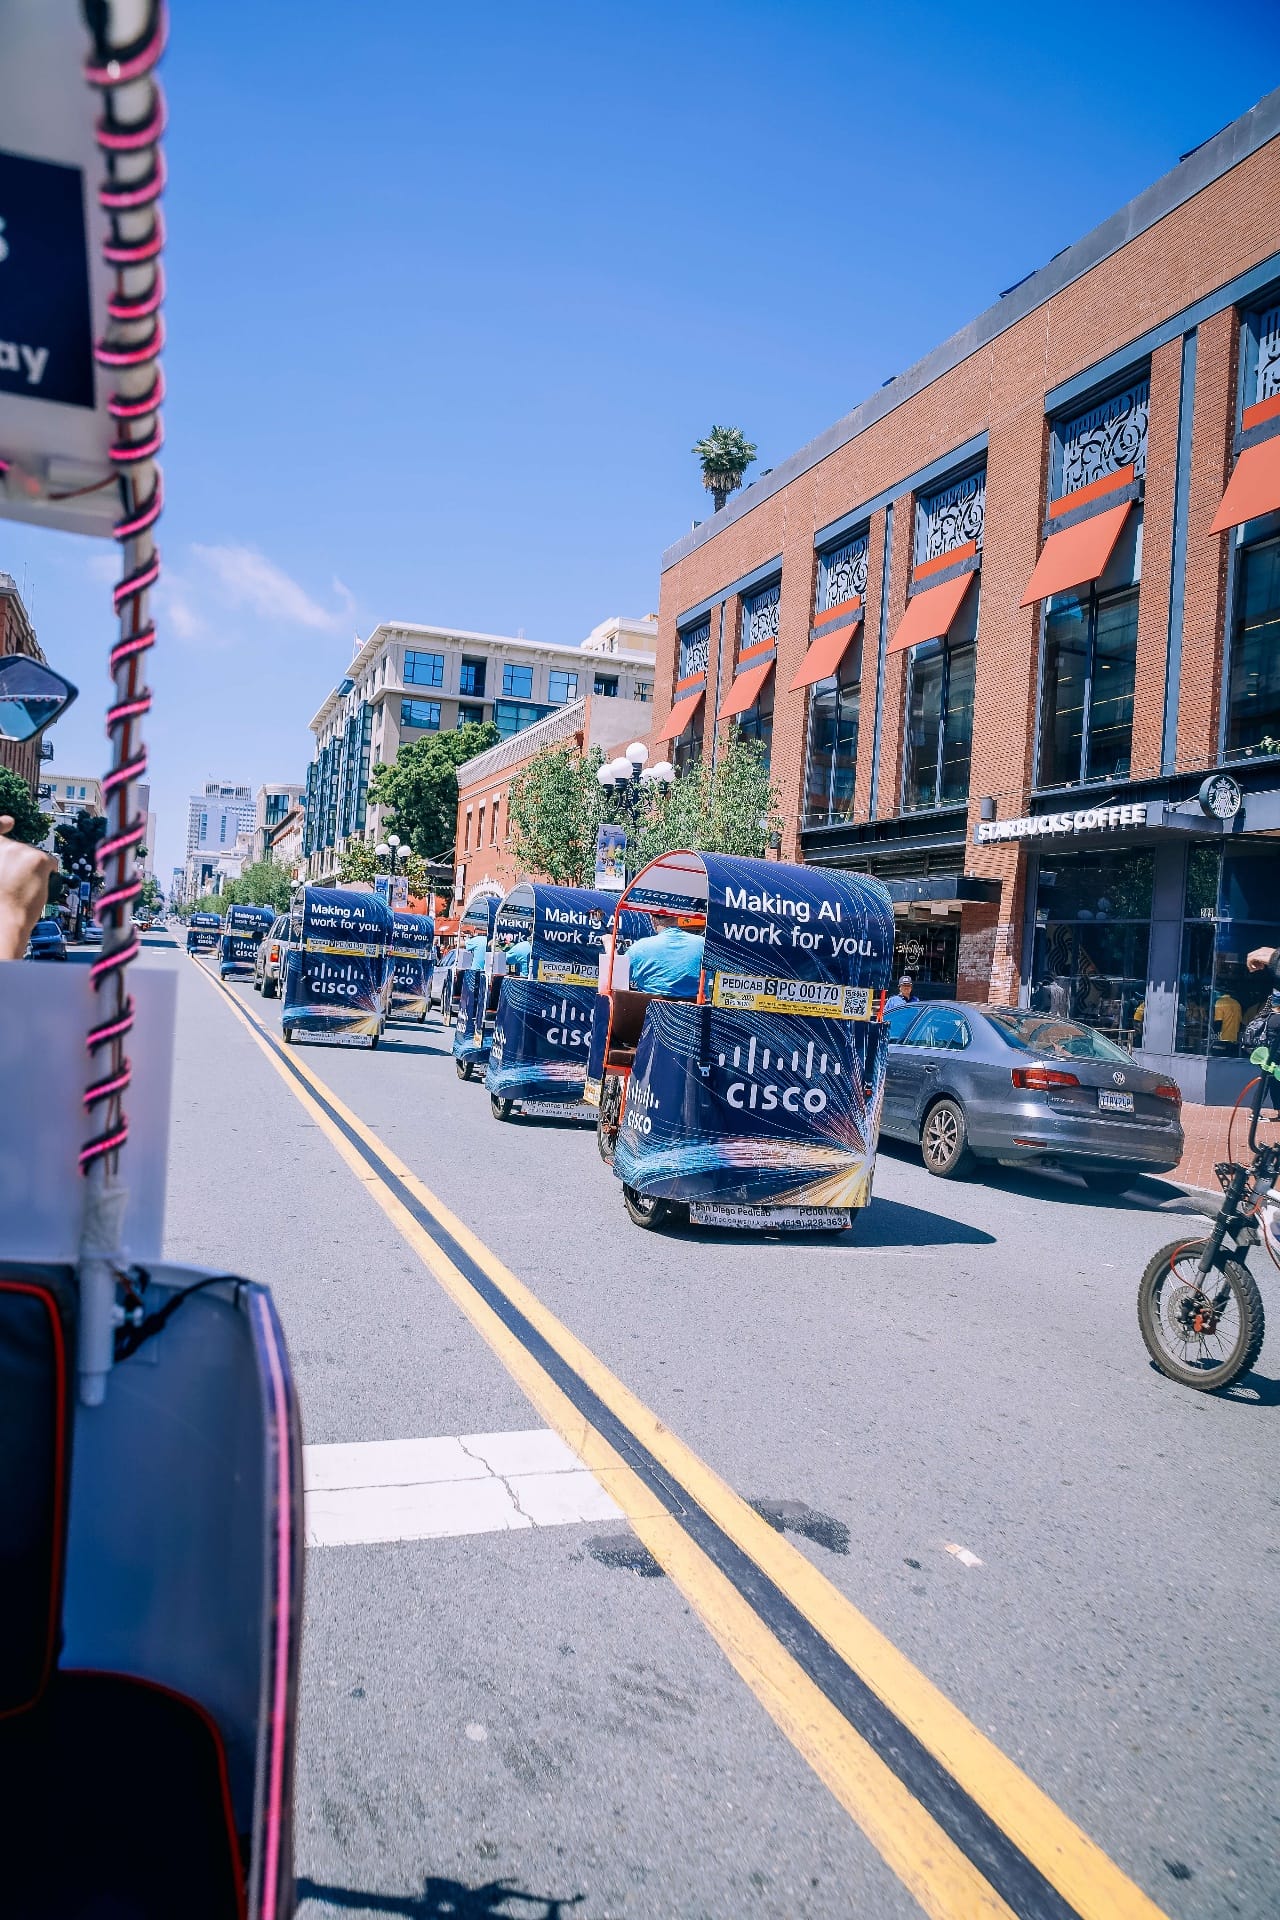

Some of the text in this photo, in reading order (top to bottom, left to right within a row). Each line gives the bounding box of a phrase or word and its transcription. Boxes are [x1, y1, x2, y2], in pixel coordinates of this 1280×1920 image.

[978, 803, 1147, 840] STARBUCKS COFFEE
[311, 903, 365, 918] Making AI
[725, 886, 841, 922] Making AI
[311, 918, 381, 932] work for you.
[544, 930, 582, 944] work
[723, 922, 782, 945] work
[791, 929, 823, 950] for
[831, 936, 877, 958] you.
[312, 982, 357, 996] CISCO
[393, 976, 413, 985] SCO
[722, 978, 763, 990] PEDICAB
[800, 984, 838, 1000] 00170
[546, 1028, 592, 1046] CISC
[727, 1083, 826, 1113] CISCO
[628, 1110, 652, 1134] CISCO
[713, 1205, 735, 1216] Diego
[738, 1207, 771, 1217] Pedicab
